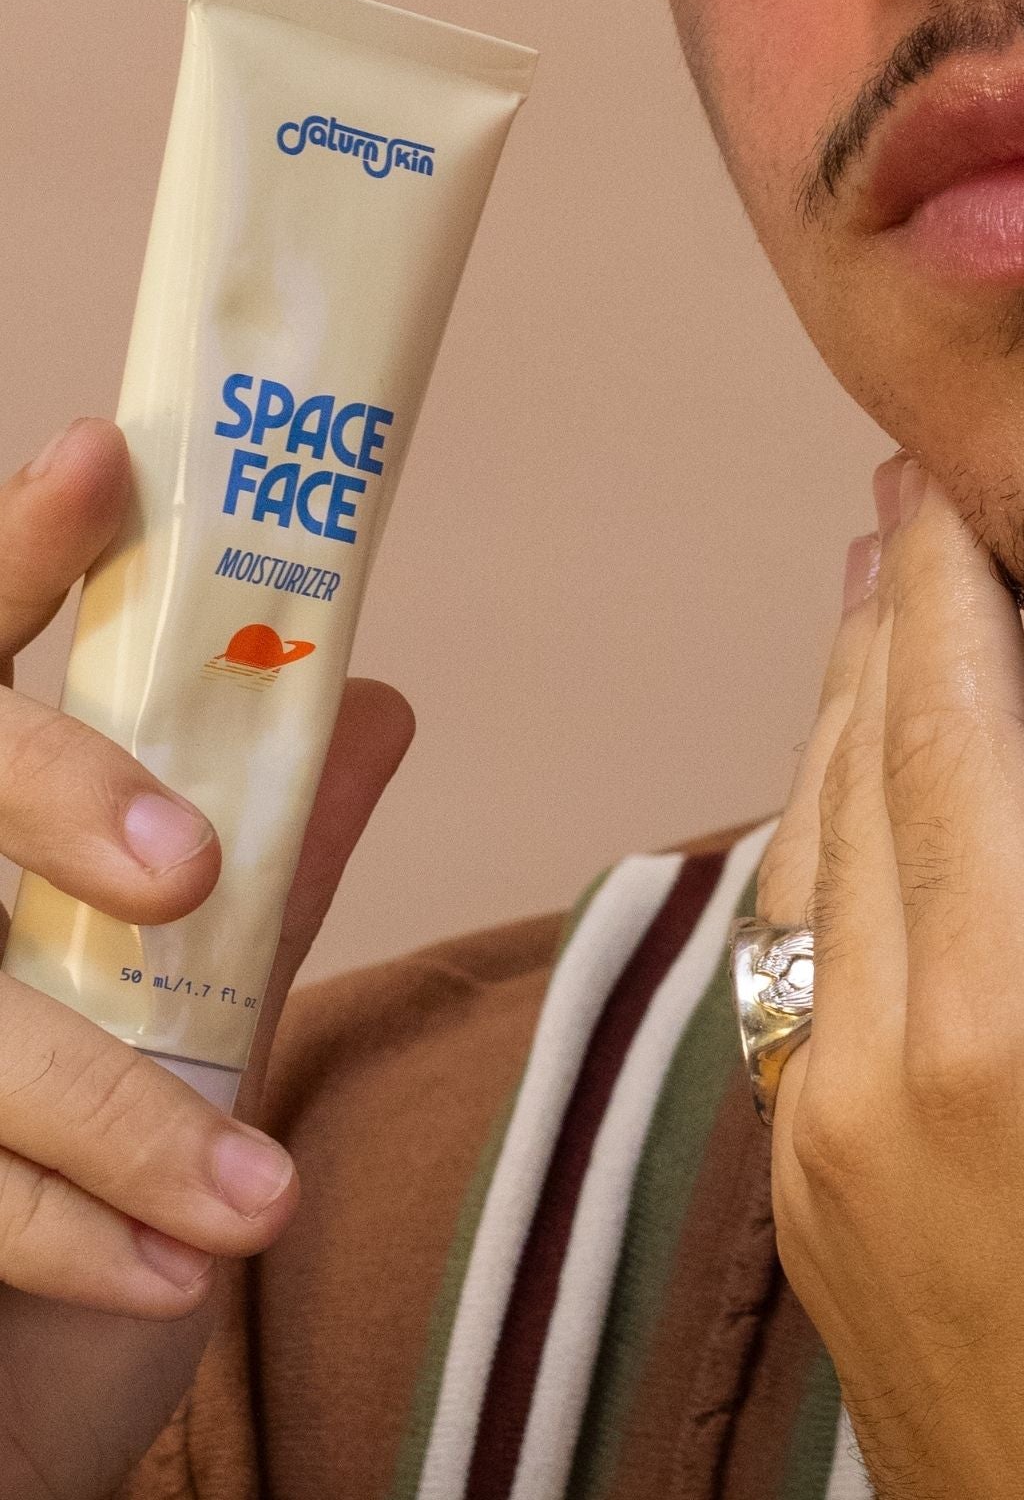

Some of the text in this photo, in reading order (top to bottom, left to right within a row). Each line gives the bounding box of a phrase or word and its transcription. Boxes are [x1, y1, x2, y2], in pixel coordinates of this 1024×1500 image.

[276, 114, 436, 179] Saturn Skin
[213, 372, 395, 477] SPACE
[221, 447, 368, 545] FACE
[214, 546, 342, 602] MOISTURIZER
[119, 967, 257, 1009] 50 mL/1.7 fl oz
